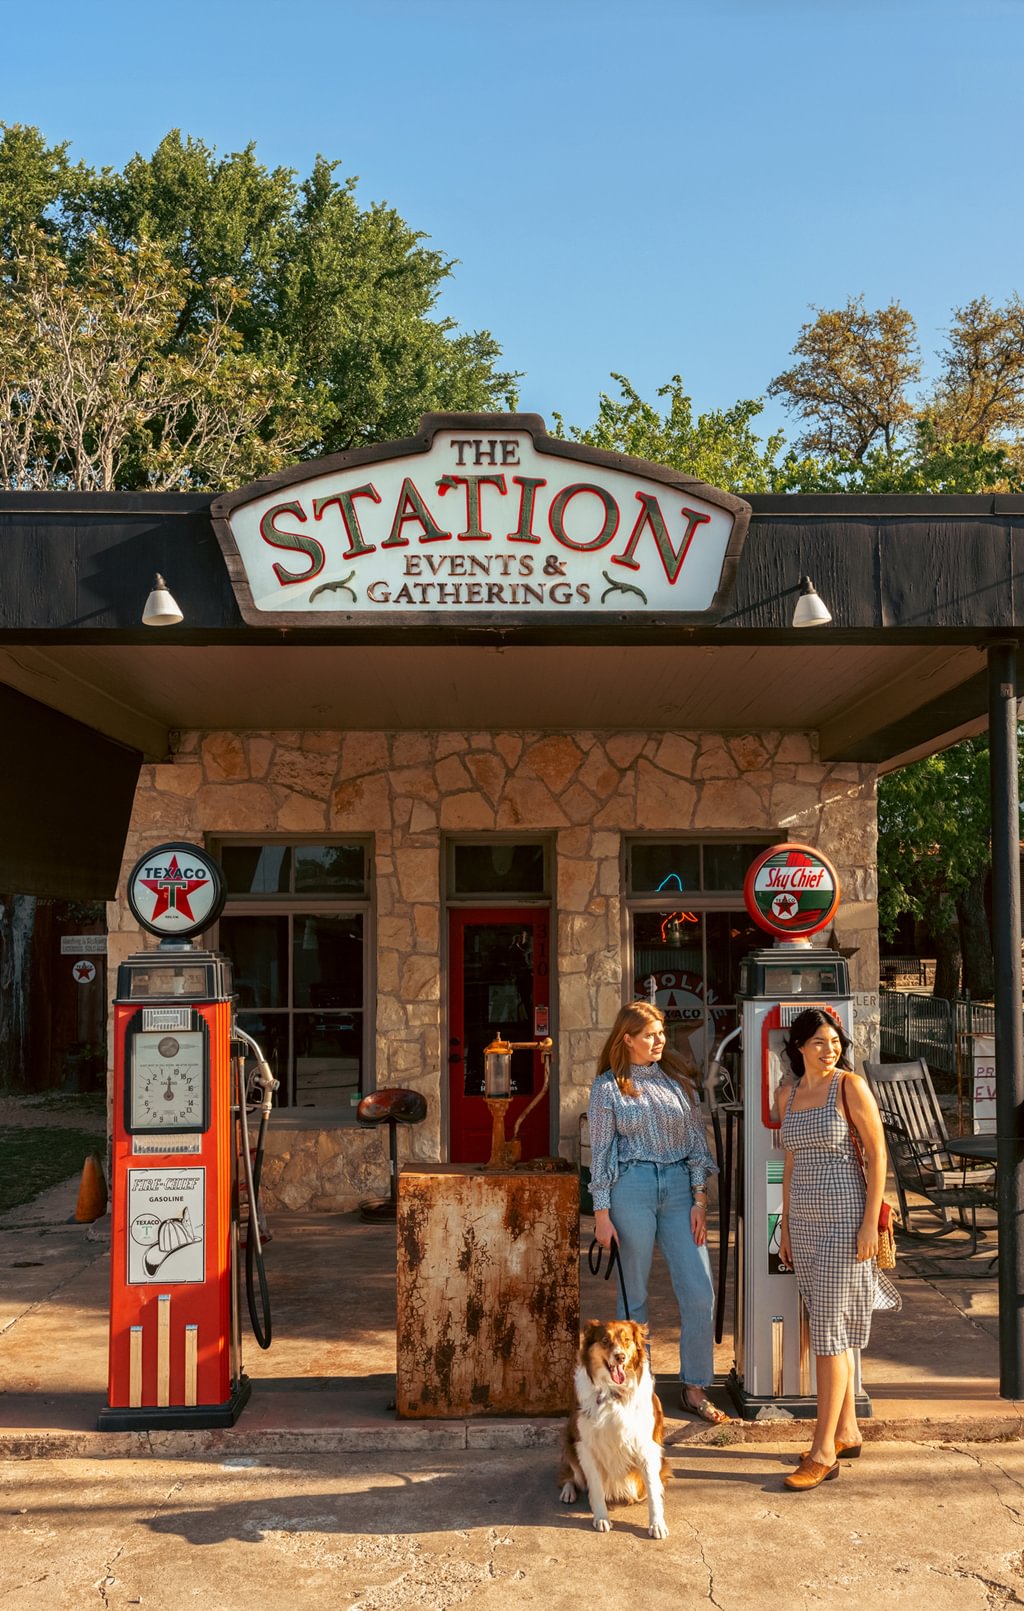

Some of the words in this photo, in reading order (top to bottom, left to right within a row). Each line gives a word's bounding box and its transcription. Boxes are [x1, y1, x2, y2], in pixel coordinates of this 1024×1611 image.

[450, 439, 521, 466] THE
[259, 473, 711, 587] STATION
[402, 554, 534, 577] EVENTS
[543, 554, 567, 577] &
[366, 581, 591, 605] GATHERINGS
[145, 867, 206, 879] TEXACO
[765, 867, 790, 890] Sky
[790, 867, 824, 888] Chief
[853, 995, 877, 1006] LER
[132, 1177, 200, 1191] FIRE-CHIEF
